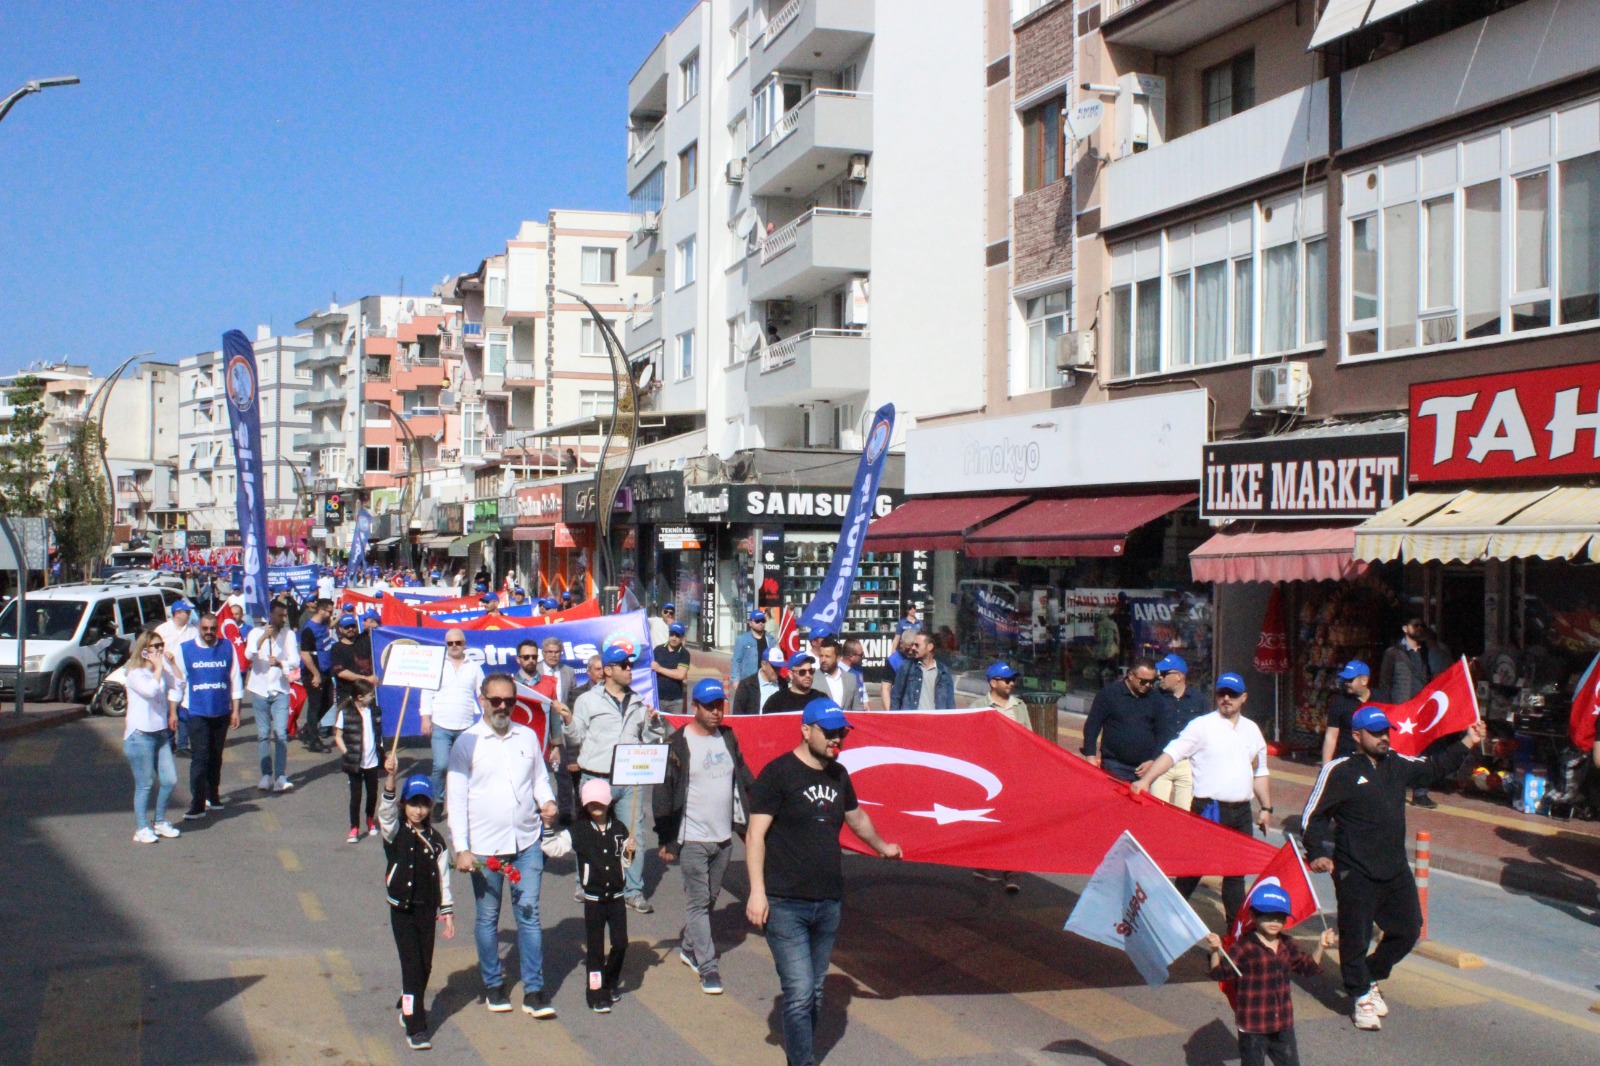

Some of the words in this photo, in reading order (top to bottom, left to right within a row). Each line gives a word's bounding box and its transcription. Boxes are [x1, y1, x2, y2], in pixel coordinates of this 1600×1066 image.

[1418, 387, 1600, 465] TAH
[964, 438, 1040, 482] Pinokyo
[1207, 452, 1263, 510] İLKE
[1270, 456, 1399, 510] MARKET
[747, 492, 892, 517] SAMSUG
[913, 550, 928, 592] KNİK
[192, 660, 227, 668] GÖREVLİ
[862, 658, 885, 667] Servi
[803, 784, 838, 803] ITALY
